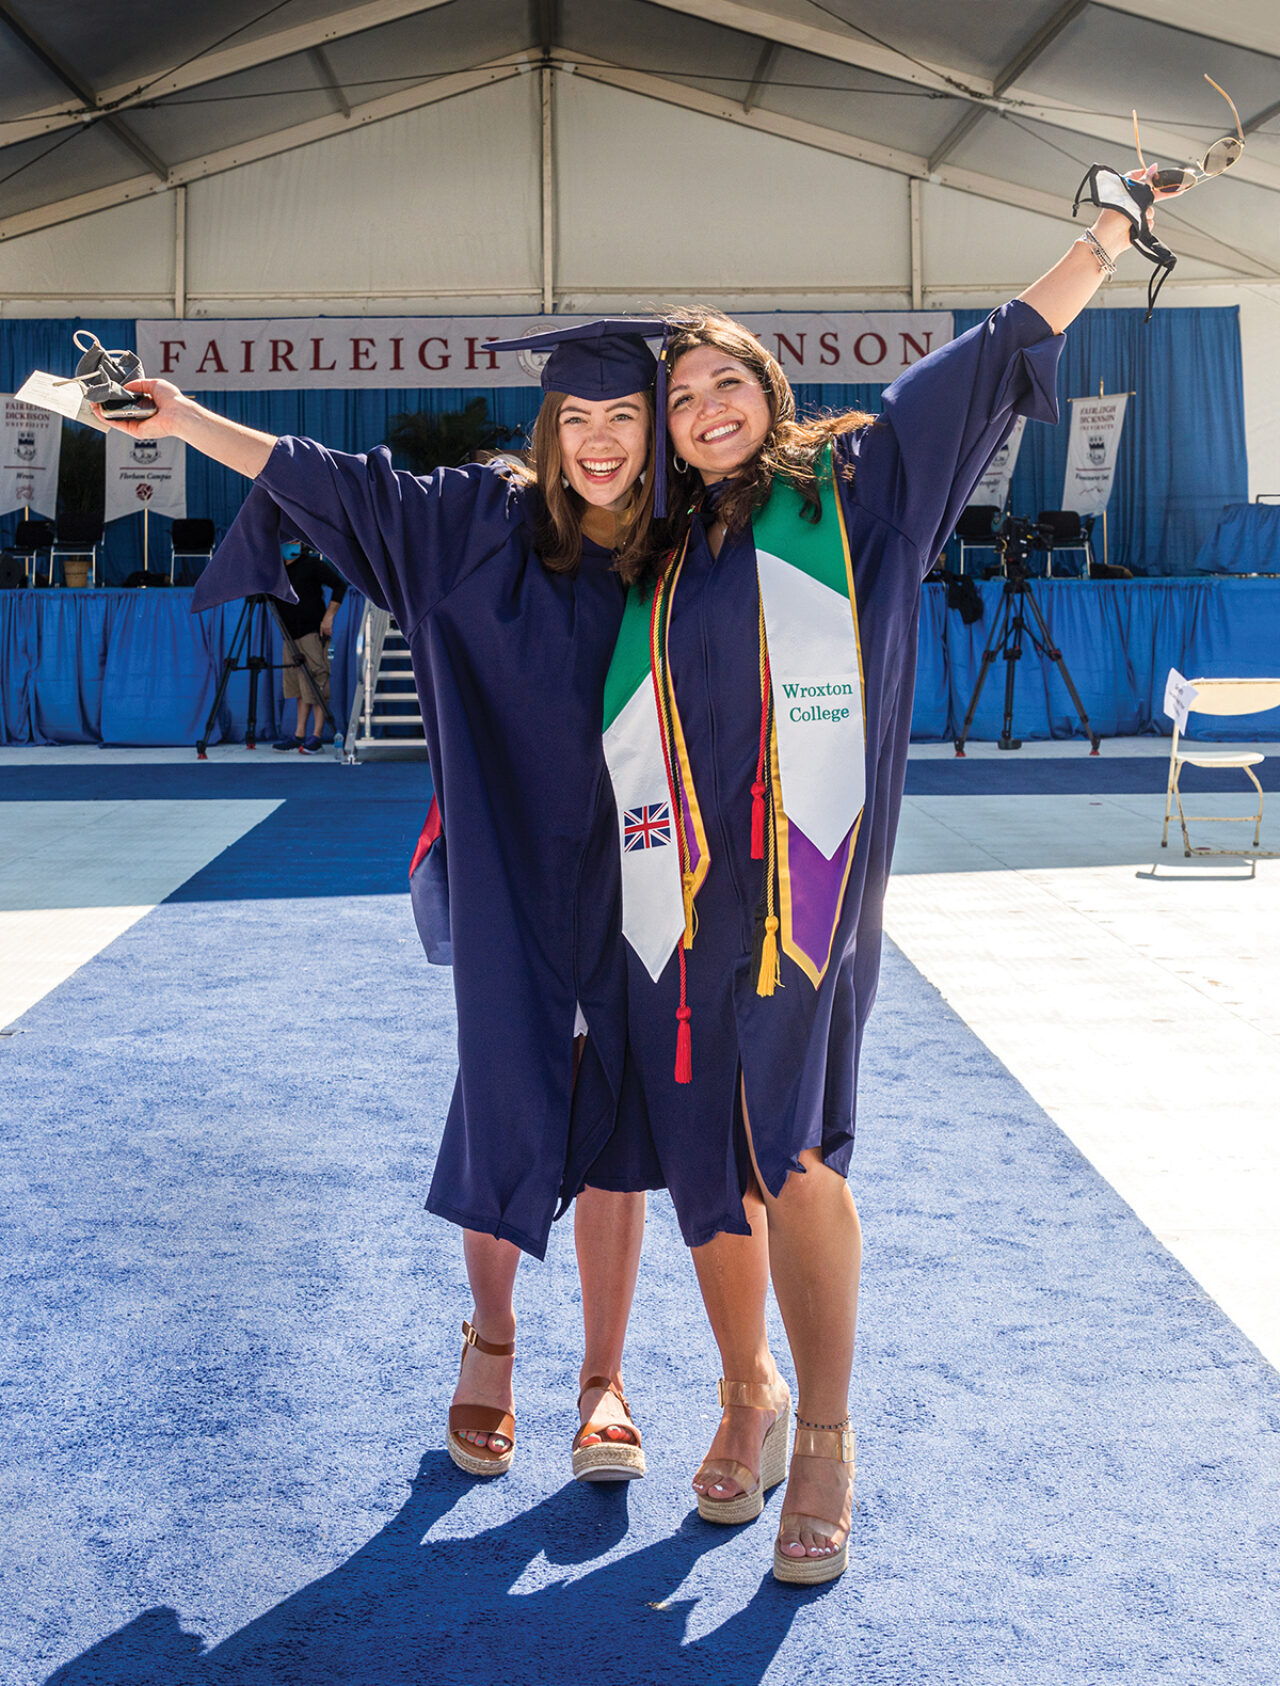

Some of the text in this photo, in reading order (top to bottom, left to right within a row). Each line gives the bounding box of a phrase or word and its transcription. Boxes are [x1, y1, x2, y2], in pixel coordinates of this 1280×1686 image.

[159, 336, 501, 374] FAIRLEIGH
[754, 331, 934, 366] NSON
[782, 682, 854, 699] Wroxton
[789, 705, 850, 723] College
